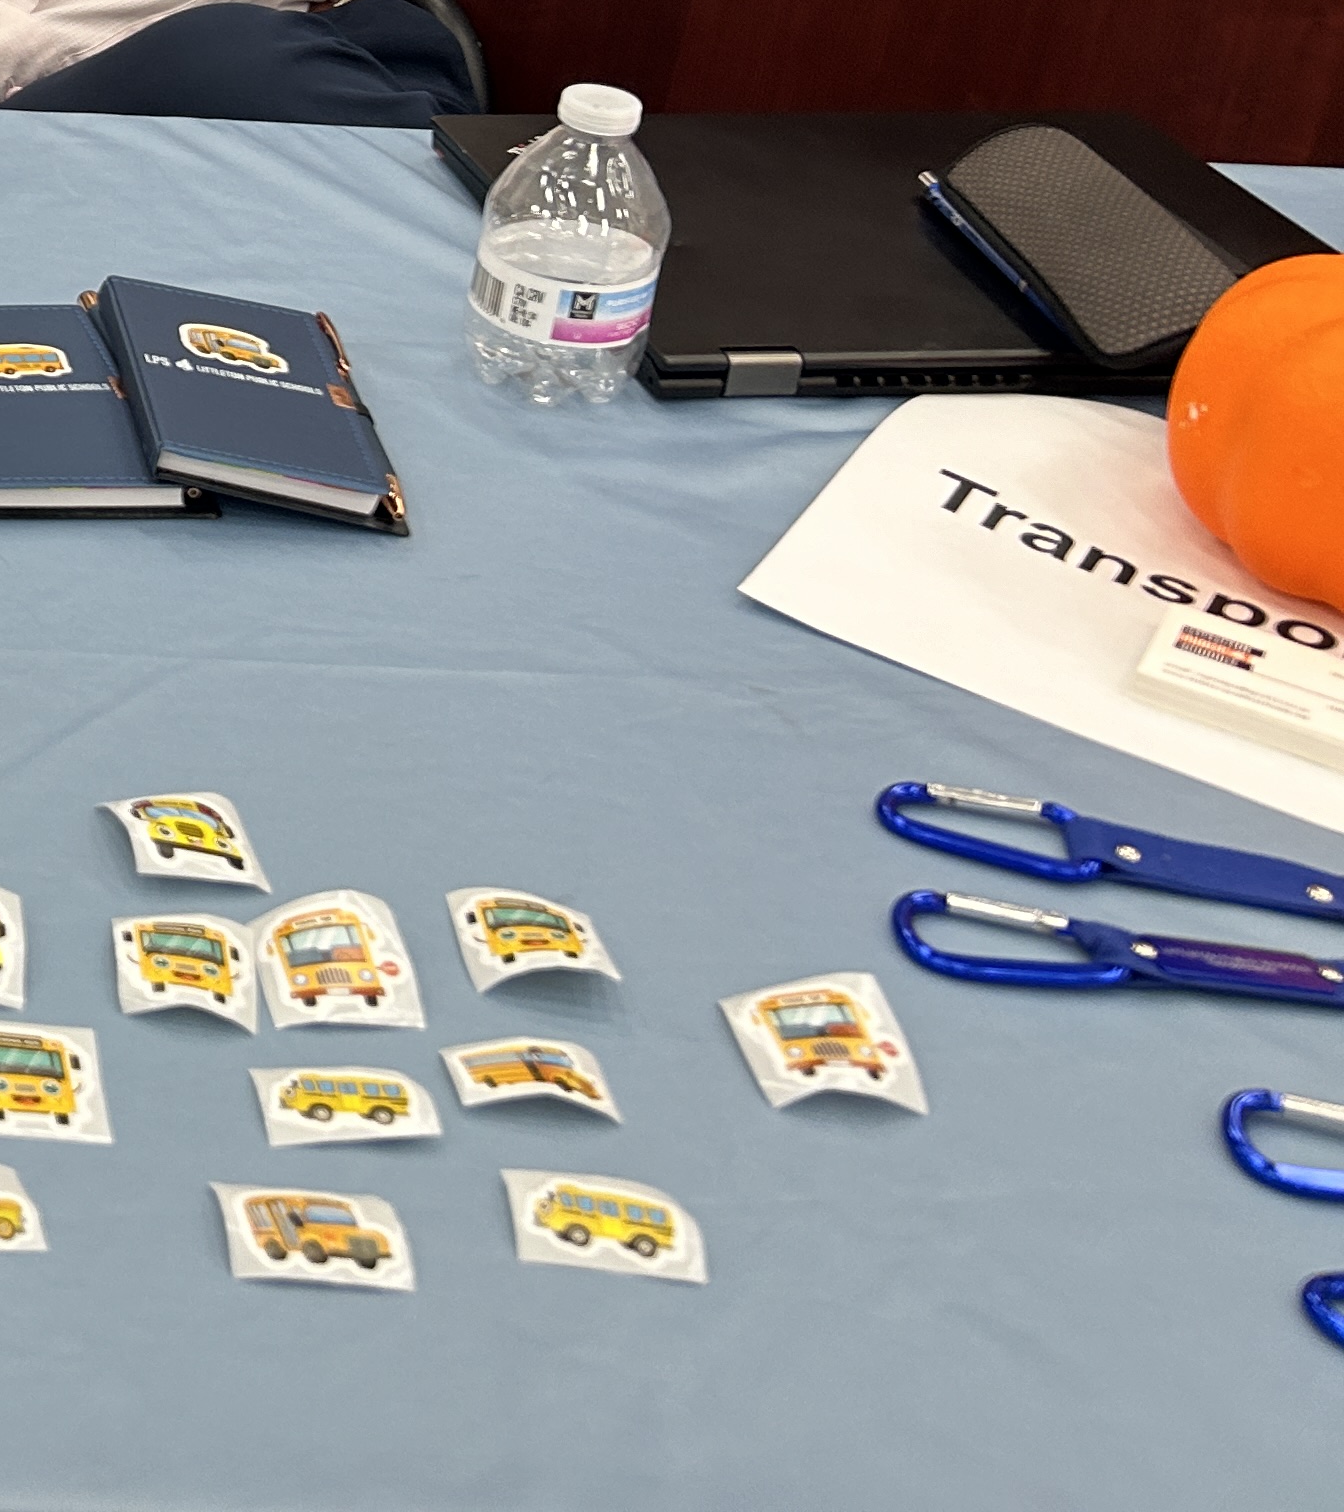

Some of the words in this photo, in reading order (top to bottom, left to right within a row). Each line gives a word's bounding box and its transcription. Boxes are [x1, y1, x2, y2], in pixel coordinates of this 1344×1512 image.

[34, 383, 68, 392] PUBLIC
[144, 353, 172, 368] LPS
[195, 364, 245, 381] LITTLETON
[245, 373, 280, 387] PUBLIC
[279, 381, 324, 396] SCHOOLS
[939, 468, 1344, 651] Transpo
